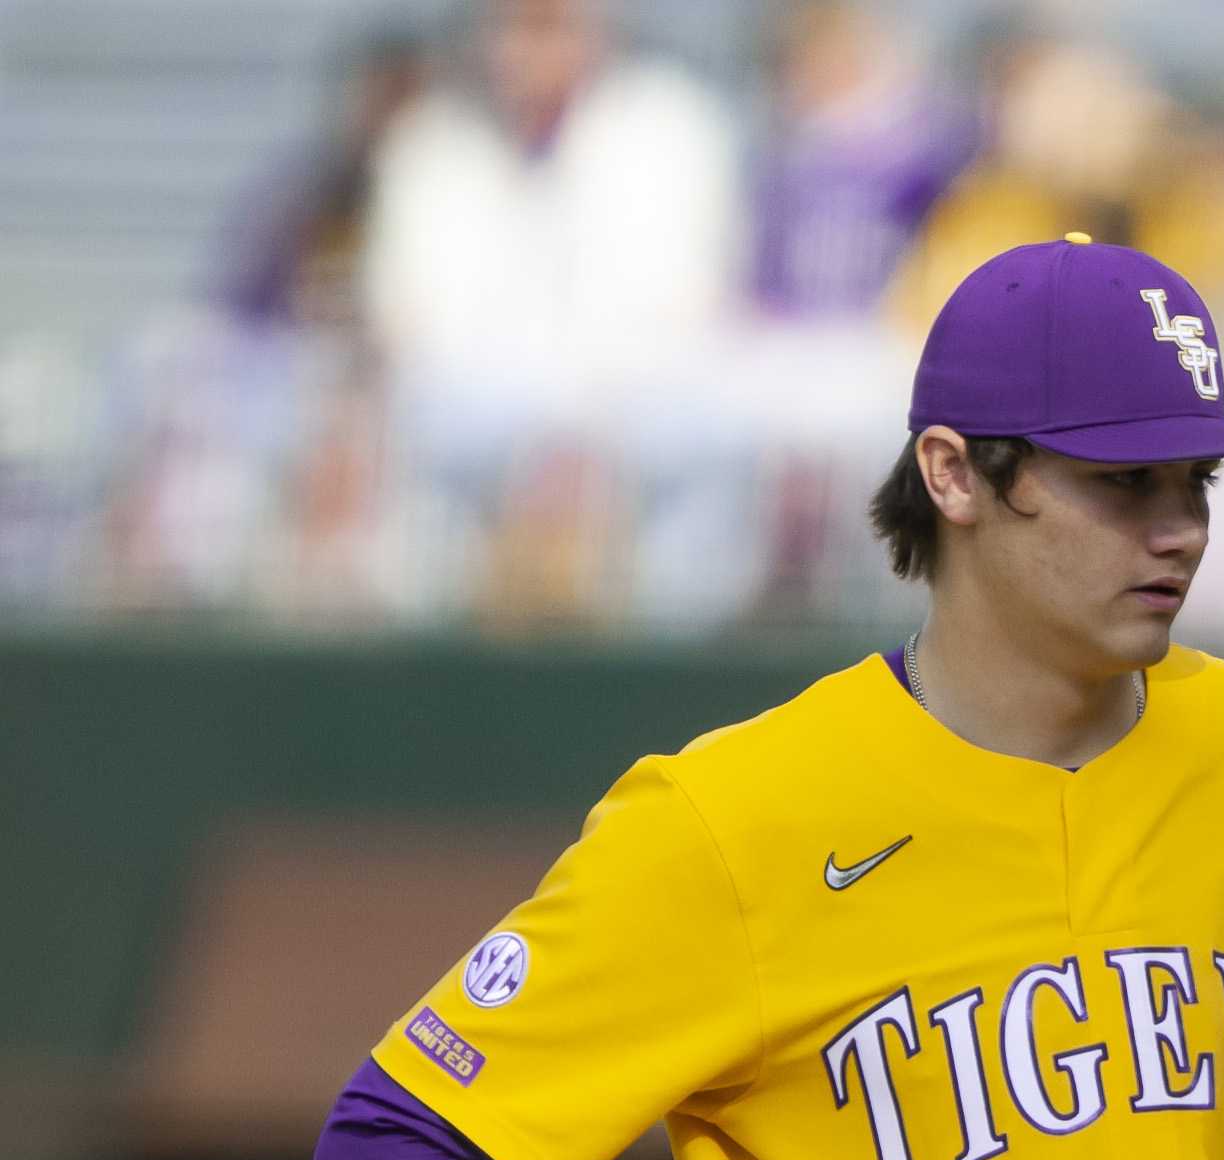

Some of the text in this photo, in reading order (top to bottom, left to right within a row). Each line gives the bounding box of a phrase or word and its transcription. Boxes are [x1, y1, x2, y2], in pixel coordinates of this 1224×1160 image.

[1140, 288, 1219, 400] LSU
[465, 934, 526, 1004] SEC
[410, 1020, 474, 1078] UNITED
[424, 1013, 476, 1063] TIGERS
